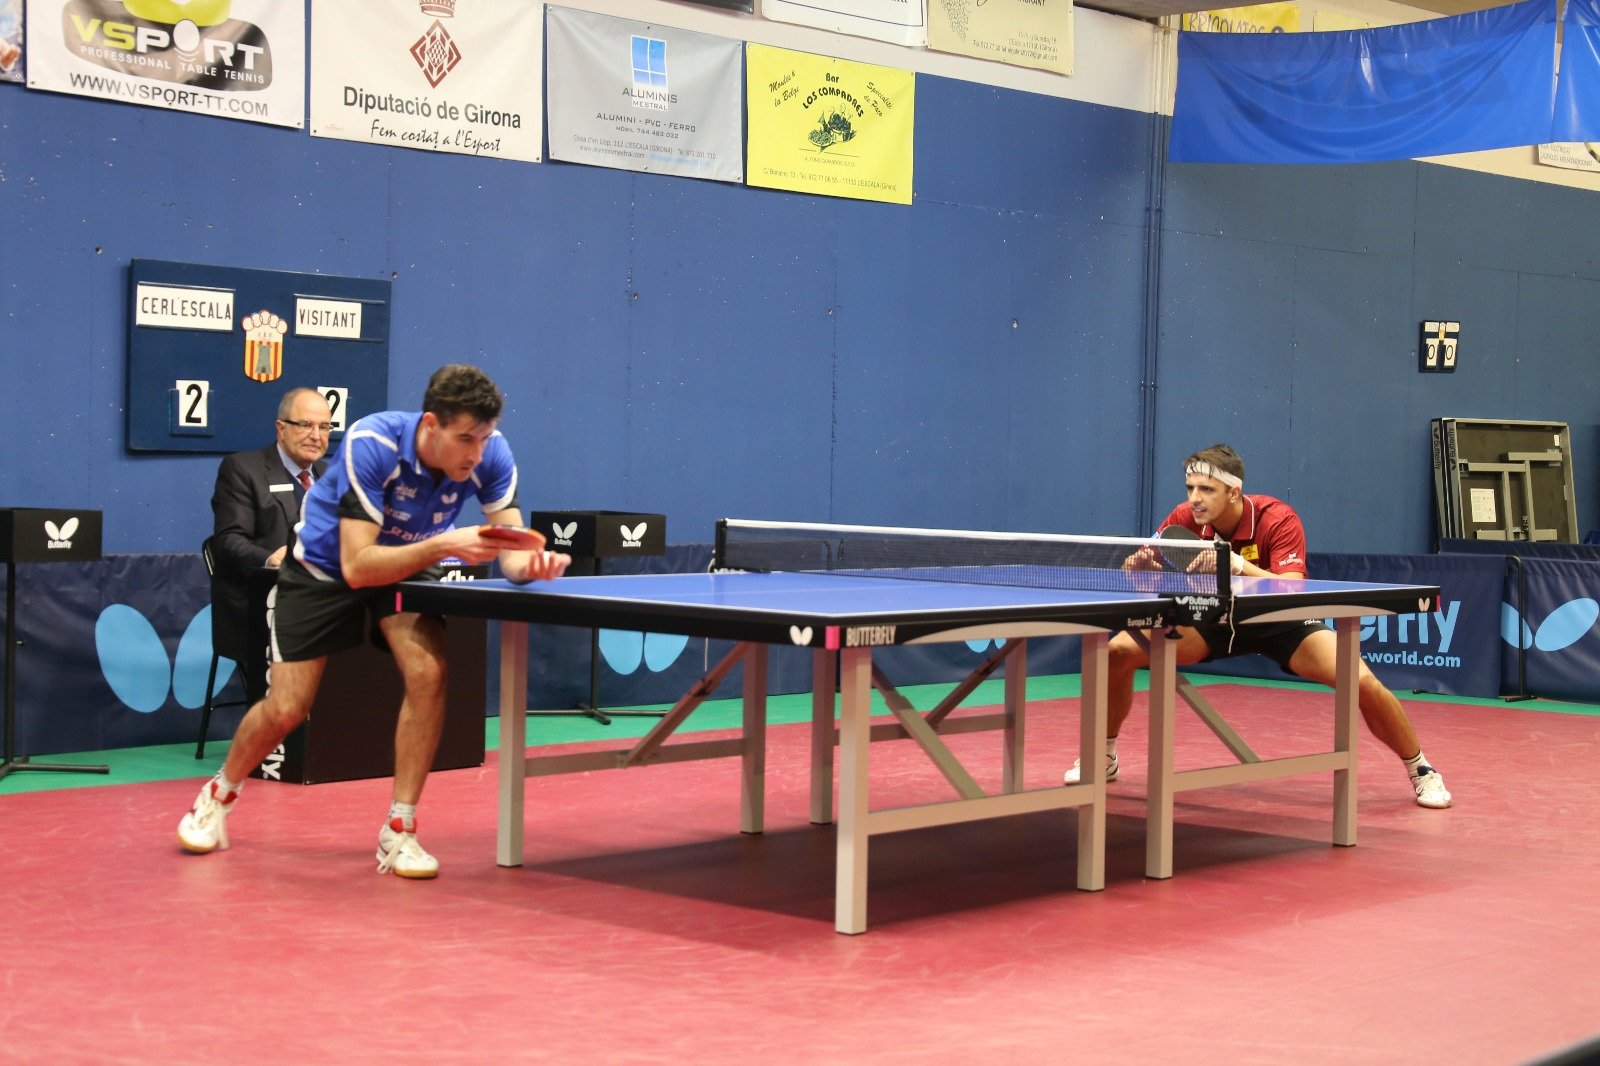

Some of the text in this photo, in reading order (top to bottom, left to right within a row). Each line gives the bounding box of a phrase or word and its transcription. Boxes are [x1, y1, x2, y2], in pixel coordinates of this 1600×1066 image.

[71, 14, 264, 70] VSPORT
[80, 45, 265, 84] PROFESSIONAL TABLE TENNIS
[825, 72, 840, 84] Bar
[69, 72, 268, 117] WWW.VSPORT-TT.COM
[622, 87, 678, 104] ALUMINIS
[802, 87, 864, 118] LOS COMPADRES
[343, 85, 521, 128] Diputació de Girona
[632, 100, 668, 111] MESTRAL
[597, 112, 696, 133] ALUMINI PVC FERRO
[371, 118, 501, 154] Fem costat a l'Esport
[299, 308, 356, 329] VISITANT
[185, 383, 202, 424] 2
[325, 389, 341, 428] 2
[48, 539, 72, 549] Butterfly
[1188, 596, 1219, 607] Butterfly
[847, 626, 896, 646] BUTTERFLY
[1360, 651, 1461, 668] -world.com
